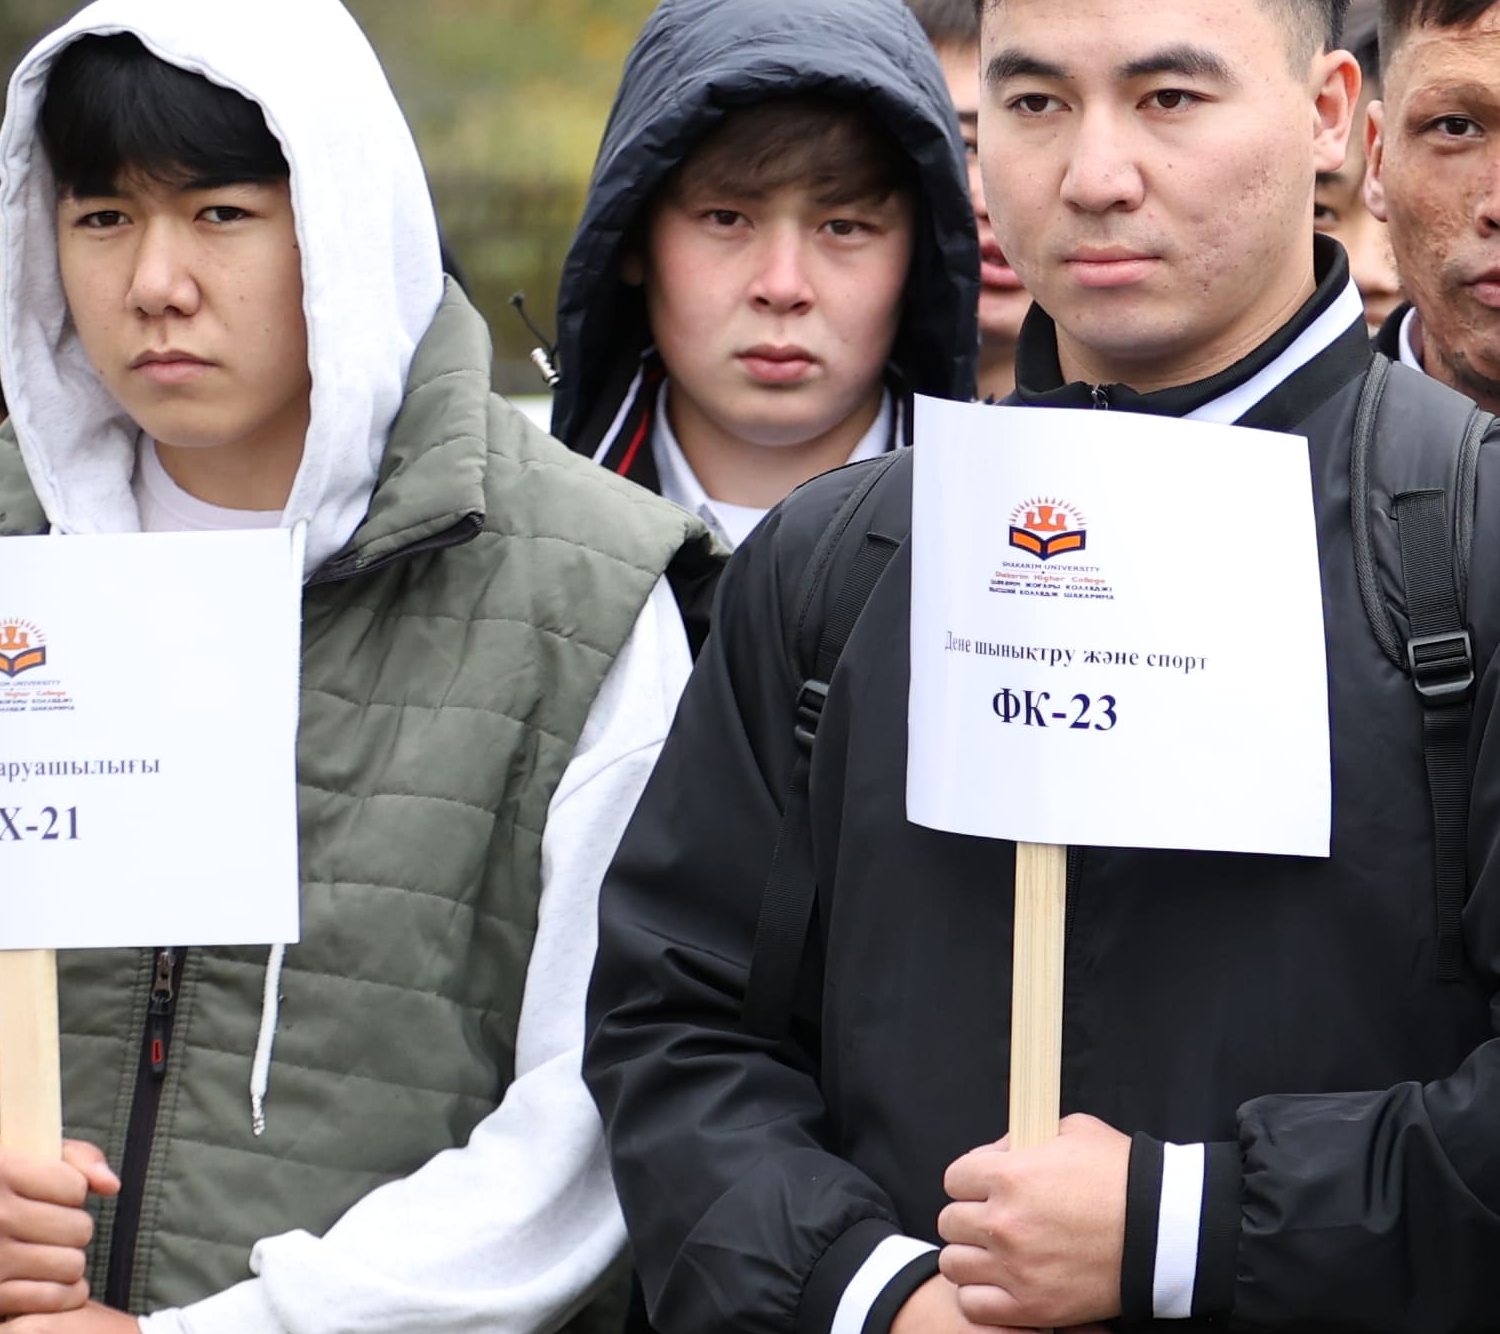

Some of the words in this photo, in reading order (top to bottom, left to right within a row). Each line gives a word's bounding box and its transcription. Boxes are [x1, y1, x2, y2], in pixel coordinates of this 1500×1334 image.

[944, 630, 971, 653] Дене
[1083, 648, 1139, 666] және
[1146, 653, 1209, 675] спорт
[992, 686, 1117, 731] ФК-23
